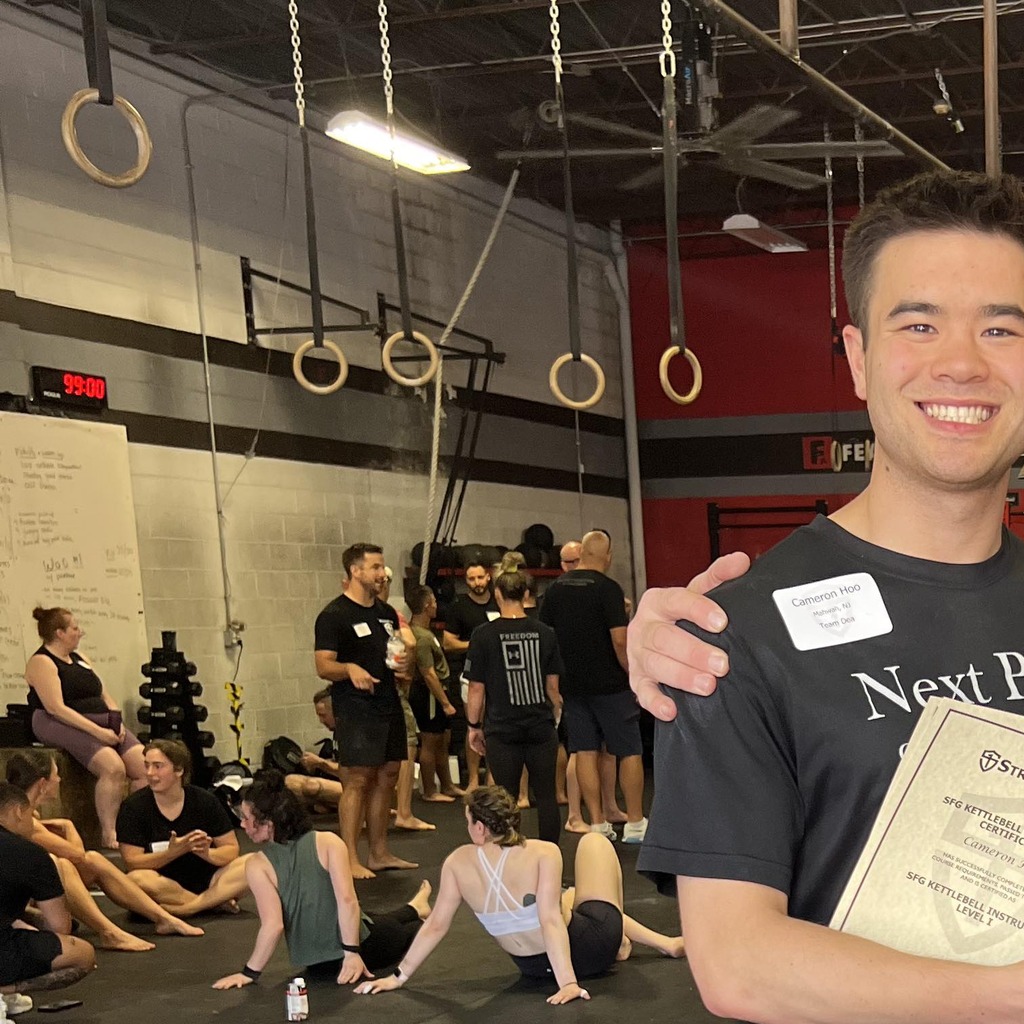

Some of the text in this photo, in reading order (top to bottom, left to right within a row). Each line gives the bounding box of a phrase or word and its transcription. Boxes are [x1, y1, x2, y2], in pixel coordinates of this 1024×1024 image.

[63, 373, 105, 399] 99:00
[791, 583, 862, 608] Cameron Hoo
[499, 632, 540, 641] FREEDOM
[819, 620, 840, 628] Team
[851, 663, 993, 721] Next
[942, 795, 964, 809] SFG
[963, 803, 1023, 834] KETTLEBELL
[942, 851, 955, 861] HAS
[955, 856, 996, 878] SUCCESSFULLY
[963, 836, 1016, 865] Cameron
[931, 854, 954, 868] COURSE
[999, 884, 1021, 898] PASSED
[960, 874, 974, 884] AND
[980, 883, 1008, 900] CERTIFIED
[1008, 896, 1017, 904] AS
[905, 871, 926, 886] SFG
[927, 879, 986, 913] KETTLEBELL
[955, 903, 994, 927] LEVEL I
